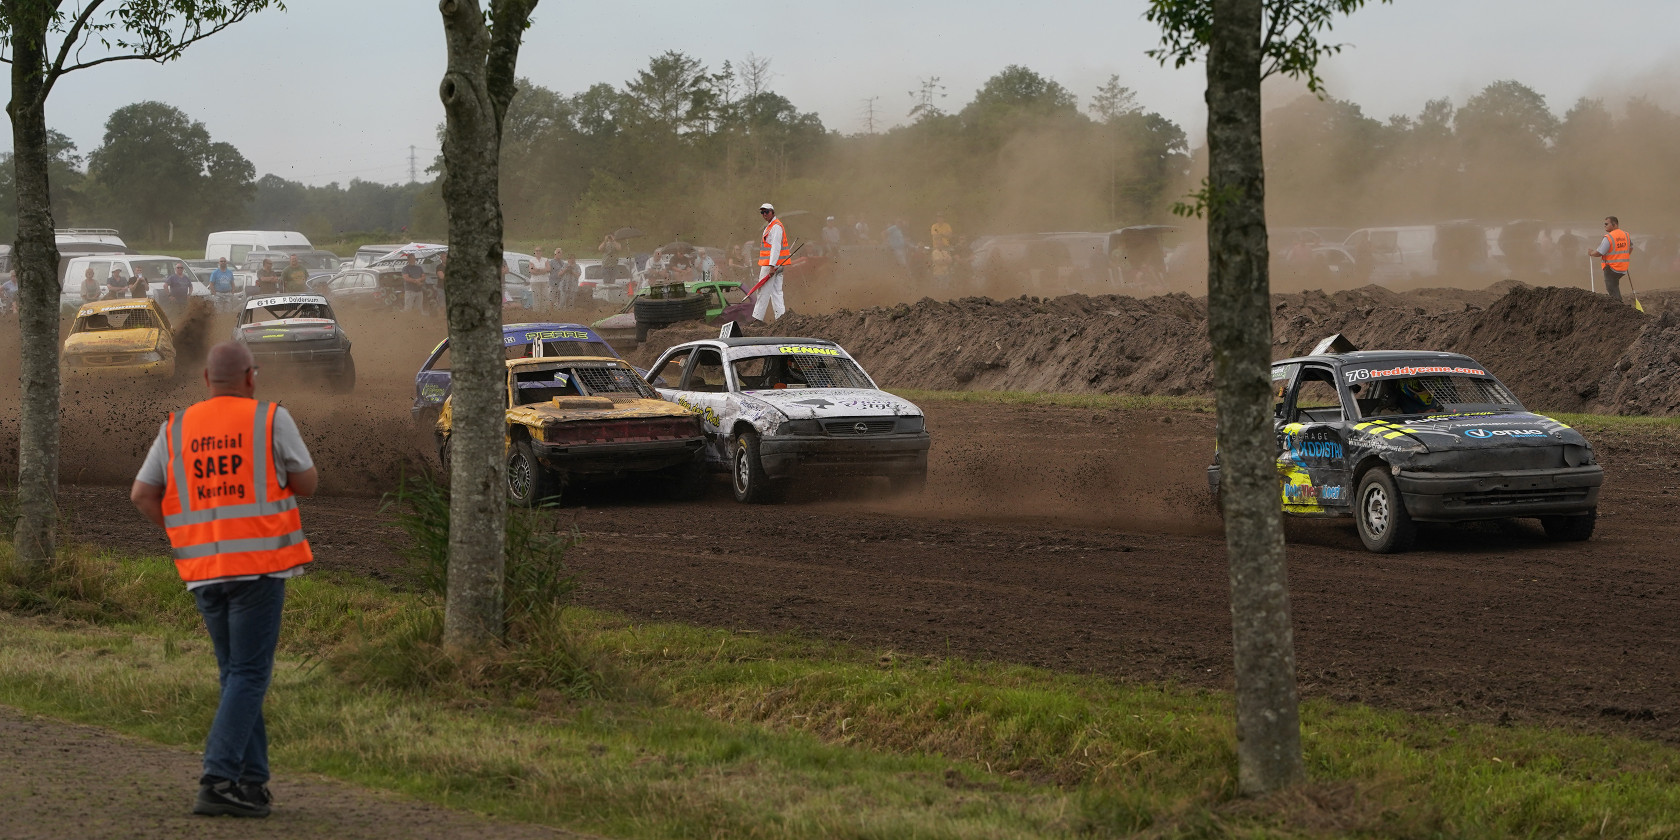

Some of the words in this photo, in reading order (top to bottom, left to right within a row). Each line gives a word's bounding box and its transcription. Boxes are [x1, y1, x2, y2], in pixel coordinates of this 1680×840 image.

[525, 330, 588, 340] PIERRE
[779, 346, 840, 355] RENNIE
[1346, 369, 1369, 382] 76
[1370, 366, 1485, 378] freddycane.com
[191, 433, 243, 452] Official
[193, 454, 243, 479] SAEP
[196, 481, 245, 501] Keuring
